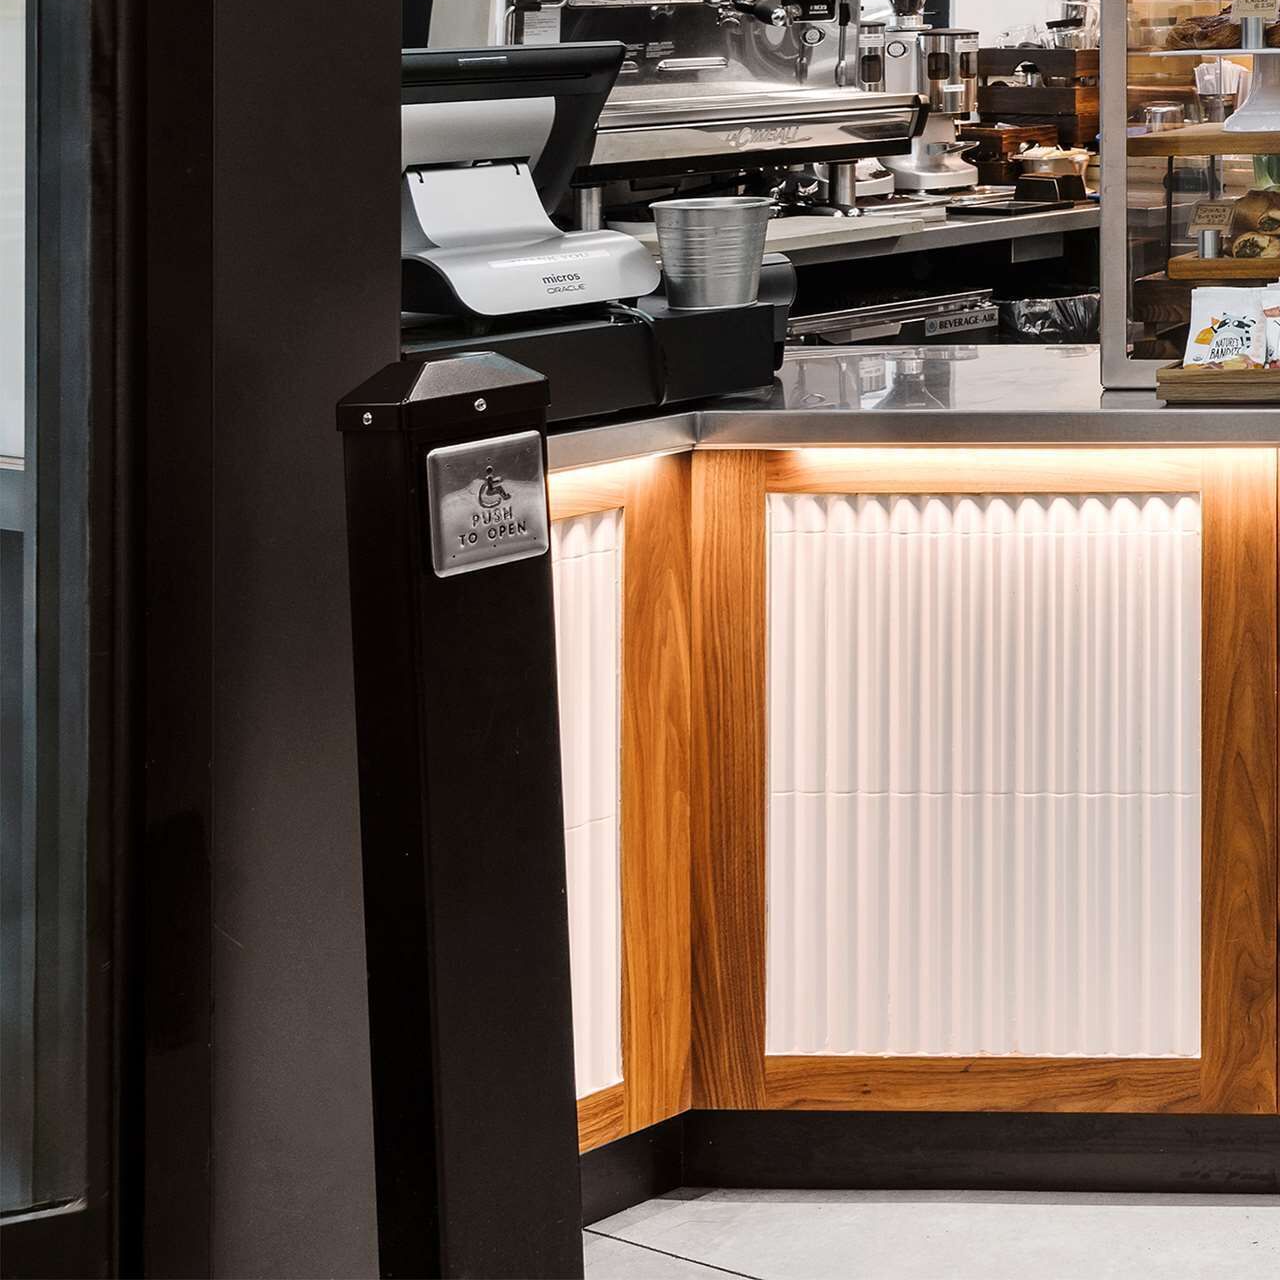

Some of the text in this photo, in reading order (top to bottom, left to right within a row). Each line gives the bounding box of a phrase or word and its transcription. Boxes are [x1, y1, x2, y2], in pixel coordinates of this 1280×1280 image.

[542, 272, 581, 285] micros
[546, 283, 586, 294] ORACLE
[1214, 336, 1239, 347] NATURE'S
[1209, 345, 1242, 359] BANDITS
[472, 506, 513, 527] PUSH
[459, 521, 528, 547] TO OPEN
